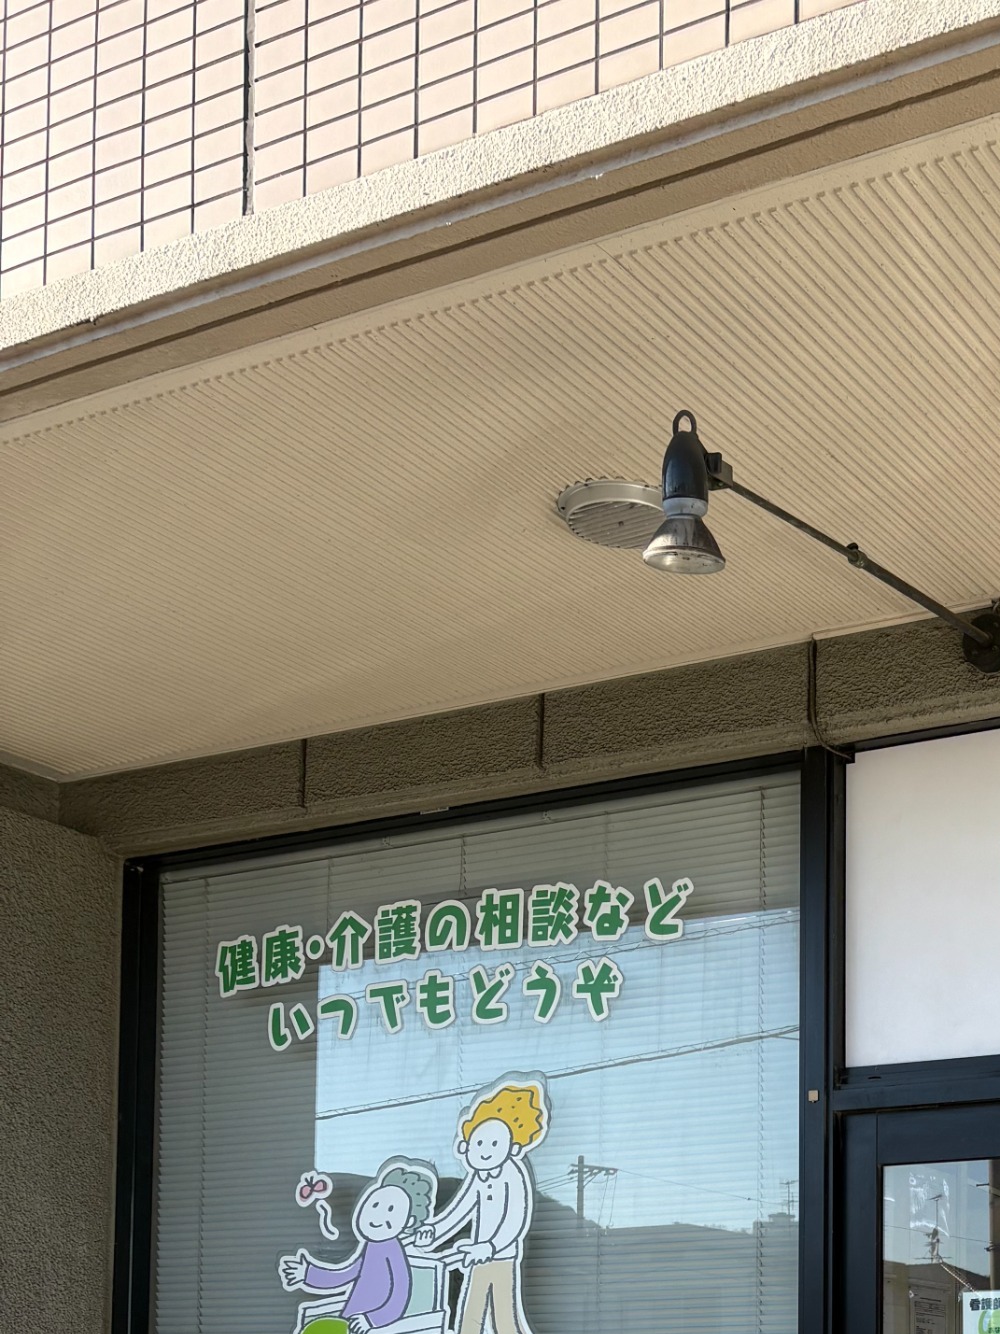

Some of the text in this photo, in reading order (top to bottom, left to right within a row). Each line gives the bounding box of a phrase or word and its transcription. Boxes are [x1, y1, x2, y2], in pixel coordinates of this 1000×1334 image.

[216, 878, 693, 996] 健康・介護の相談など
[270, 960, 621, 1048] いつでもどうぞ
